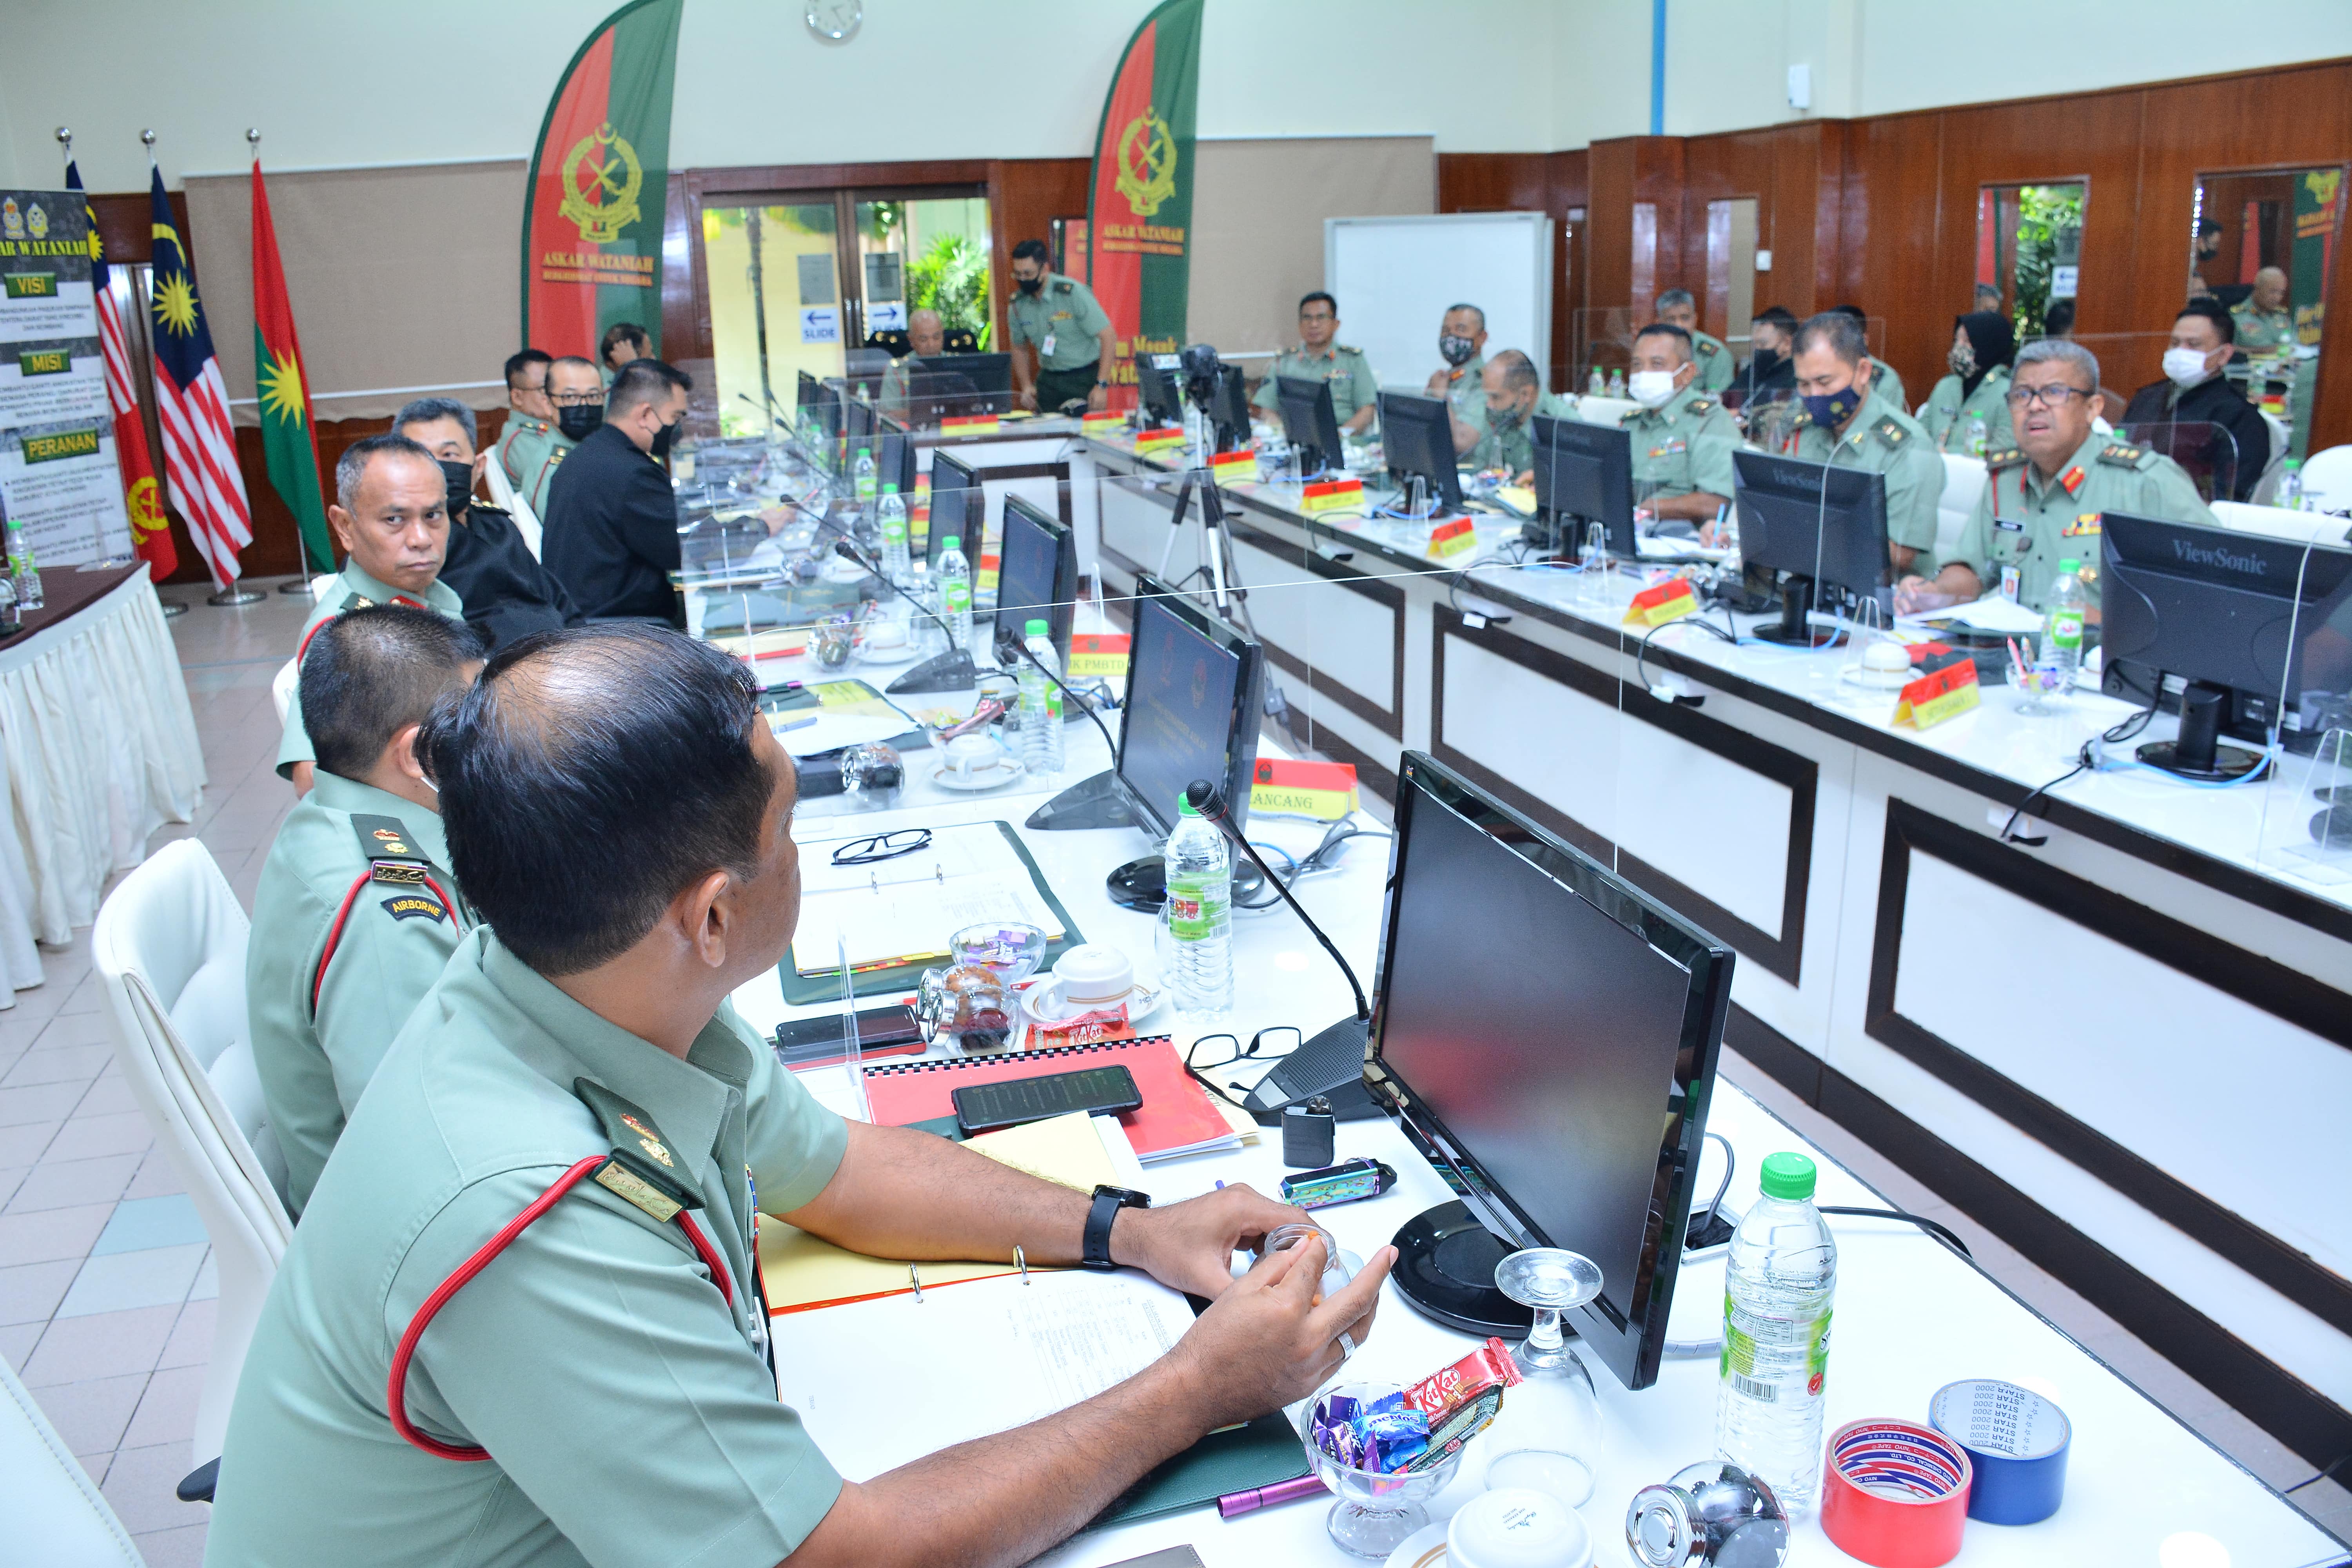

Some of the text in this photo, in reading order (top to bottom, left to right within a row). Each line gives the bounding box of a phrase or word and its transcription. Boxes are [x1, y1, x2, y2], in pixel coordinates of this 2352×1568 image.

[18, 240, 87, 256] WATANIAH
[543, 252, 584, 269] ASKAR
[17, 278, 46, 294] VISI
[805, 329, 835, 339] SLIDE
[32, 354, 62, 372] MISI
[28, 434, 96, 457] PERANAN
[2173, 539, 2267, 575] ViewSonic
[1250, 793, 1312, 809] ANCANG
[392, 900, 440, 916] AIRBORNE
[1073, 1025, 1101, 1044] KitKat
[1418, 1370, 1458, 1412] KitKat
[1735, 1387, 1752, 1398] 556145
[1997, 1395, 2019, 1405] STAR
[1996, 1403, 2018, 1413] STAR
[1367, 1414, 1419, 1428] mentos
[1995, 1410, 2017, 1421] STAR
[1994, 1418, 2016, 1428] STAR
[1993, 1426, 2015, 1437] STAR
[1992, 1434, 2014, 1445] STAR
[1434, 1453, 1446, 1463] have
[1918, 1459, 1942, 1474] CHEMICAL
[1934, 1478, 1946, 1488] NIYO
[1943, 1473, 1953, 1483] NIYO
